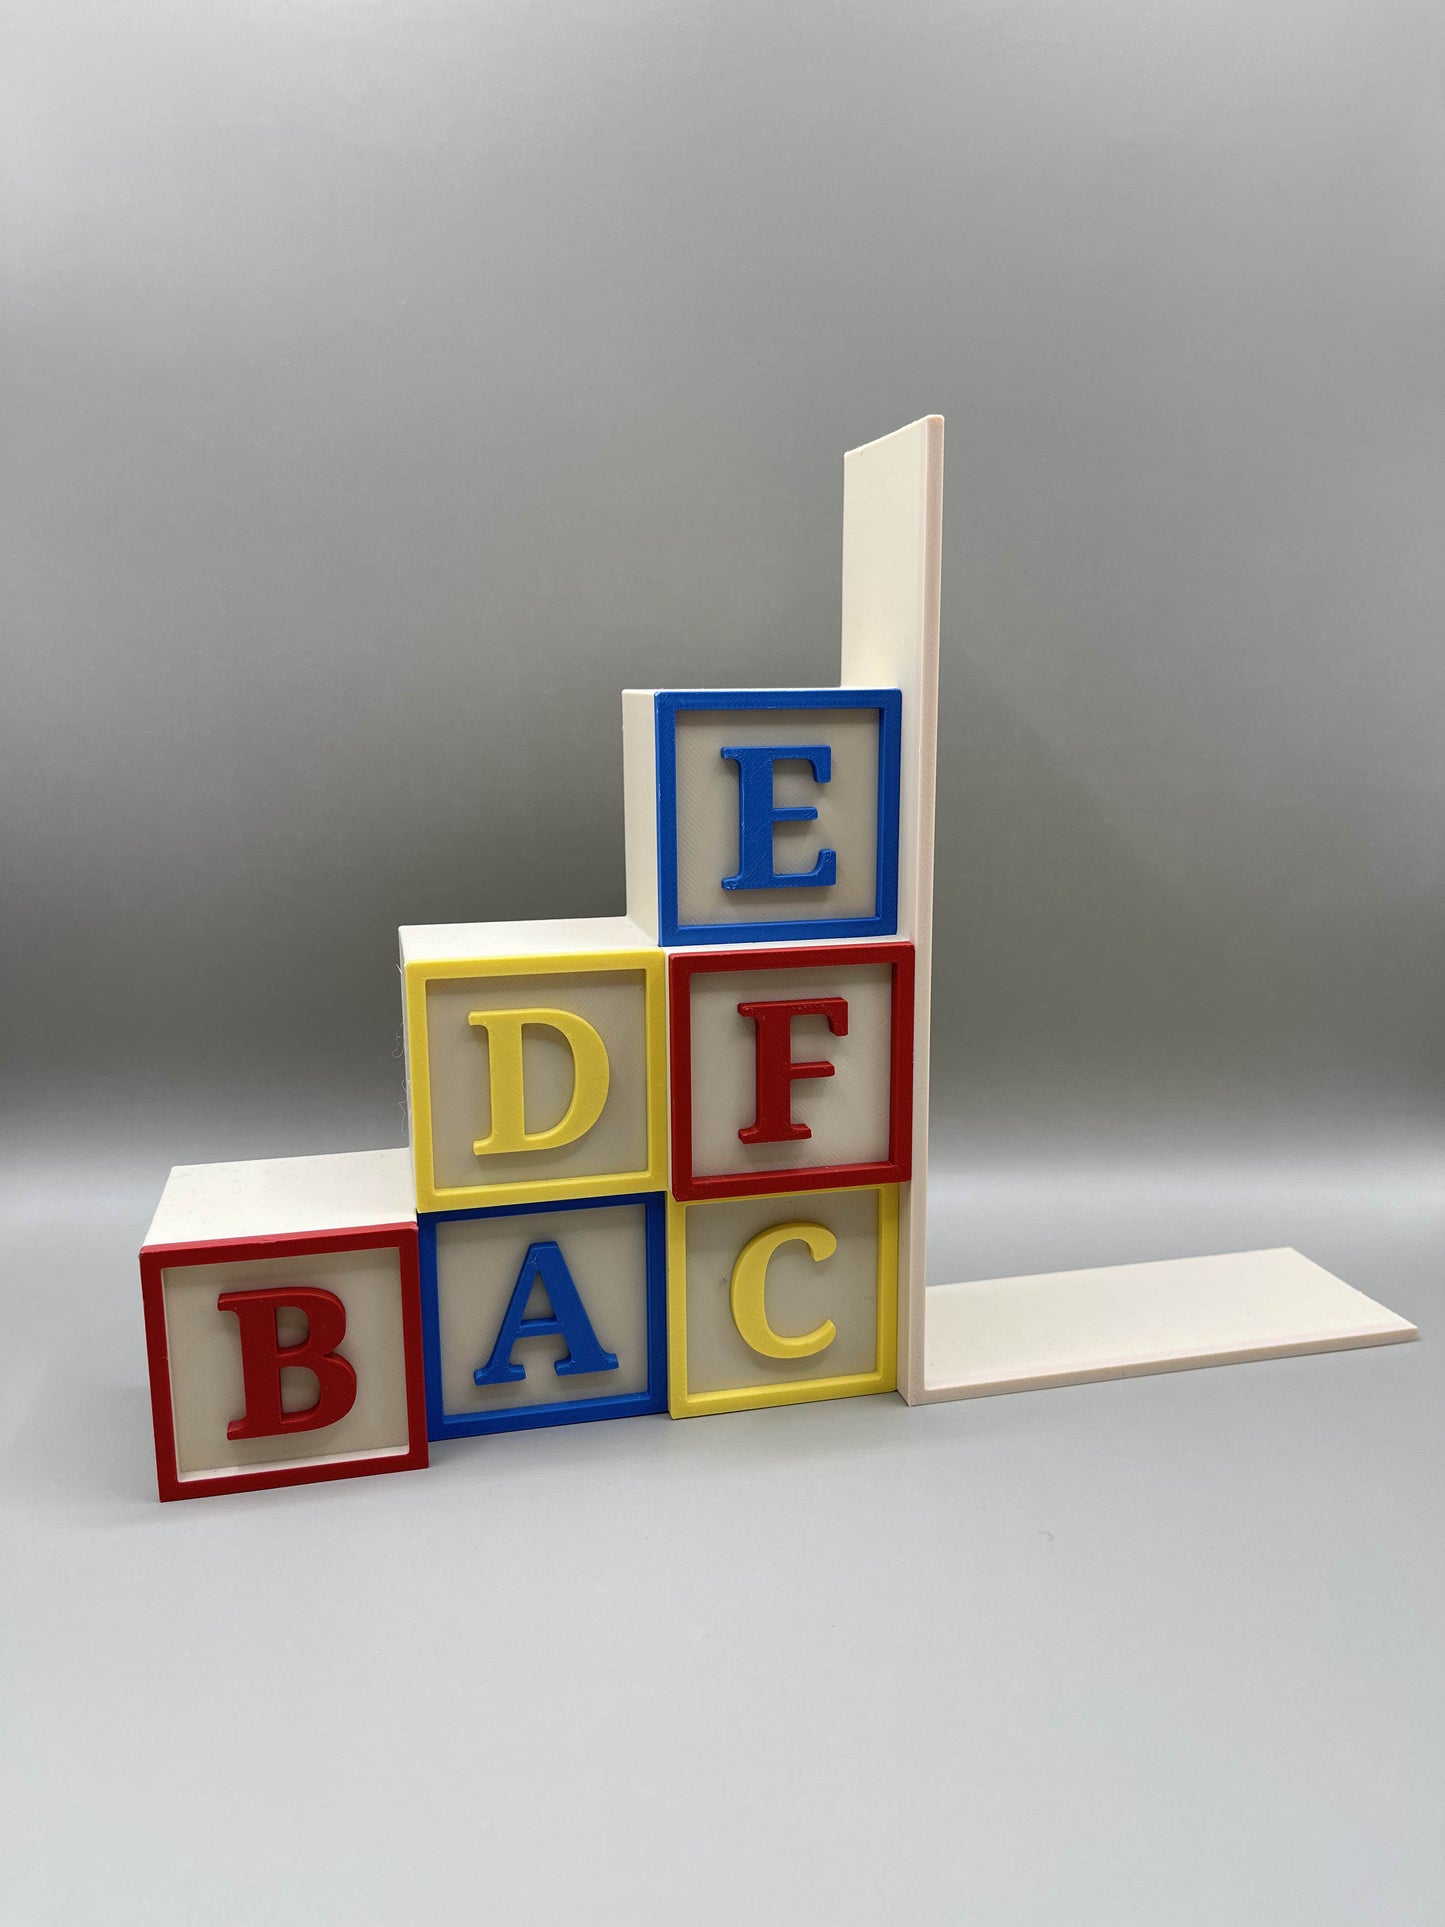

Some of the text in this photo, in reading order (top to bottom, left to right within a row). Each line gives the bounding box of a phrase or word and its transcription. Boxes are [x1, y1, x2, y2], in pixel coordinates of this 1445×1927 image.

[721, 745, 836, 890] E
[468, 1008, 610, 1156] D
[737, 998, 848, 1144] F
[475, 1242, 619, 1385] A
[731, 1222, 837, 1359] C
[218, 1287, 357, 1440] B
